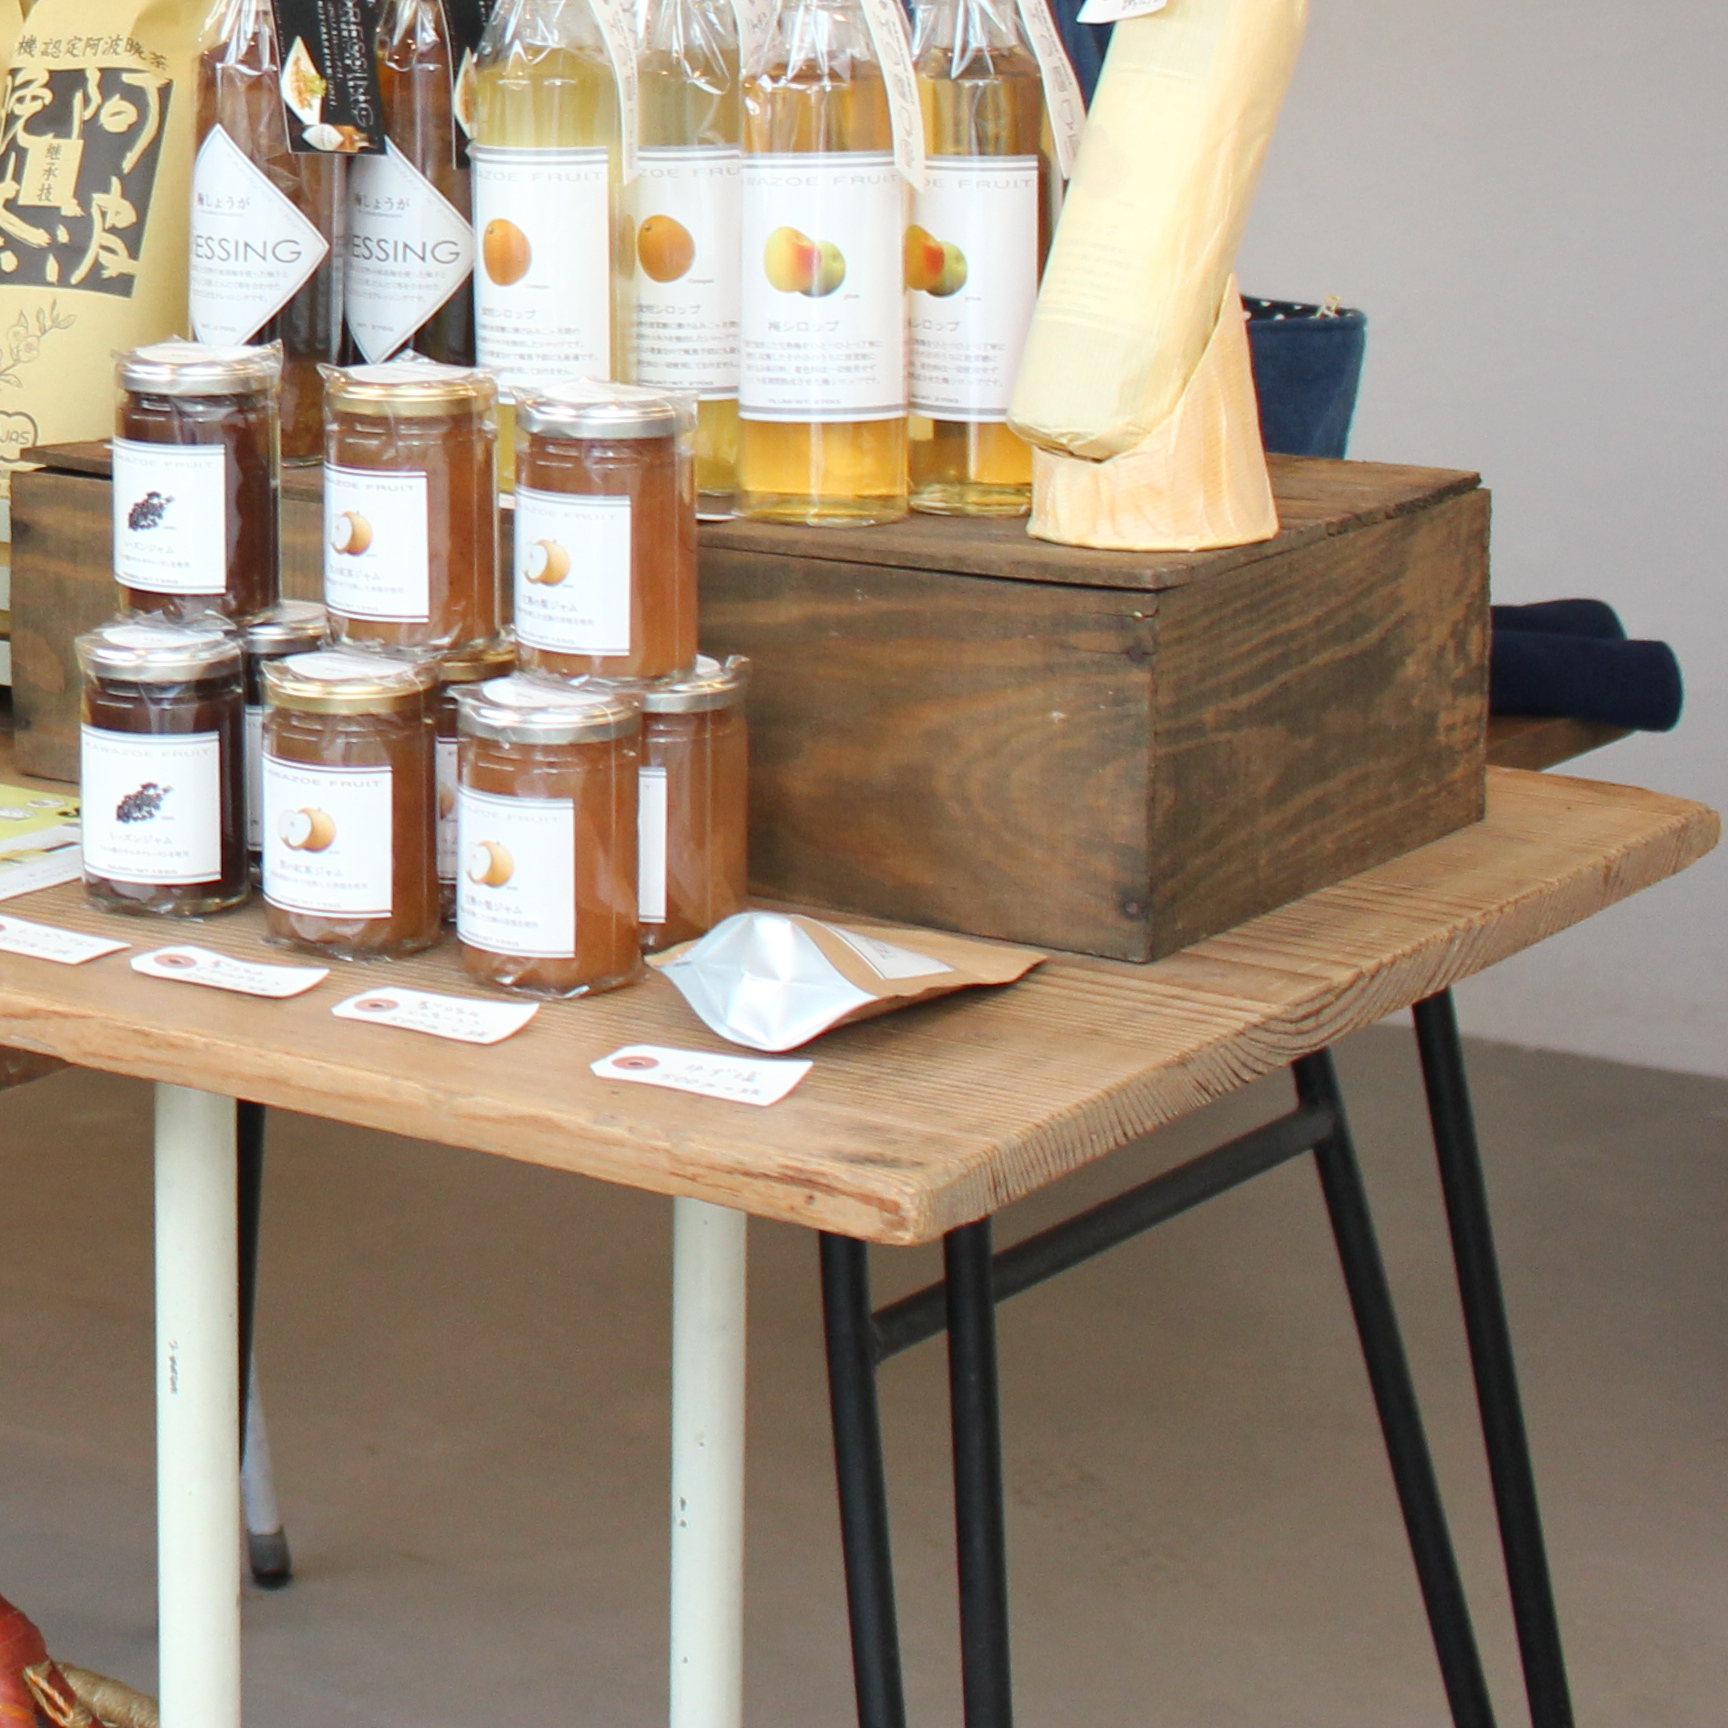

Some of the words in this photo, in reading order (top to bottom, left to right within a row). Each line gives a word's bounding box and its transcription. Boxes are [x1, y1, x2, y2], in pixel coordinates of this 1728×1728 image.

[530, 170, 604, 183] FRUIT
[833, 173, 899, 186] FRUIT
[957, 178, 1035, 190] FRUIT
[0, 429, 32, 446] JAS
[161, 748, 211, 758] FRUIT
[328, 779, 382, 788] FRUIT
